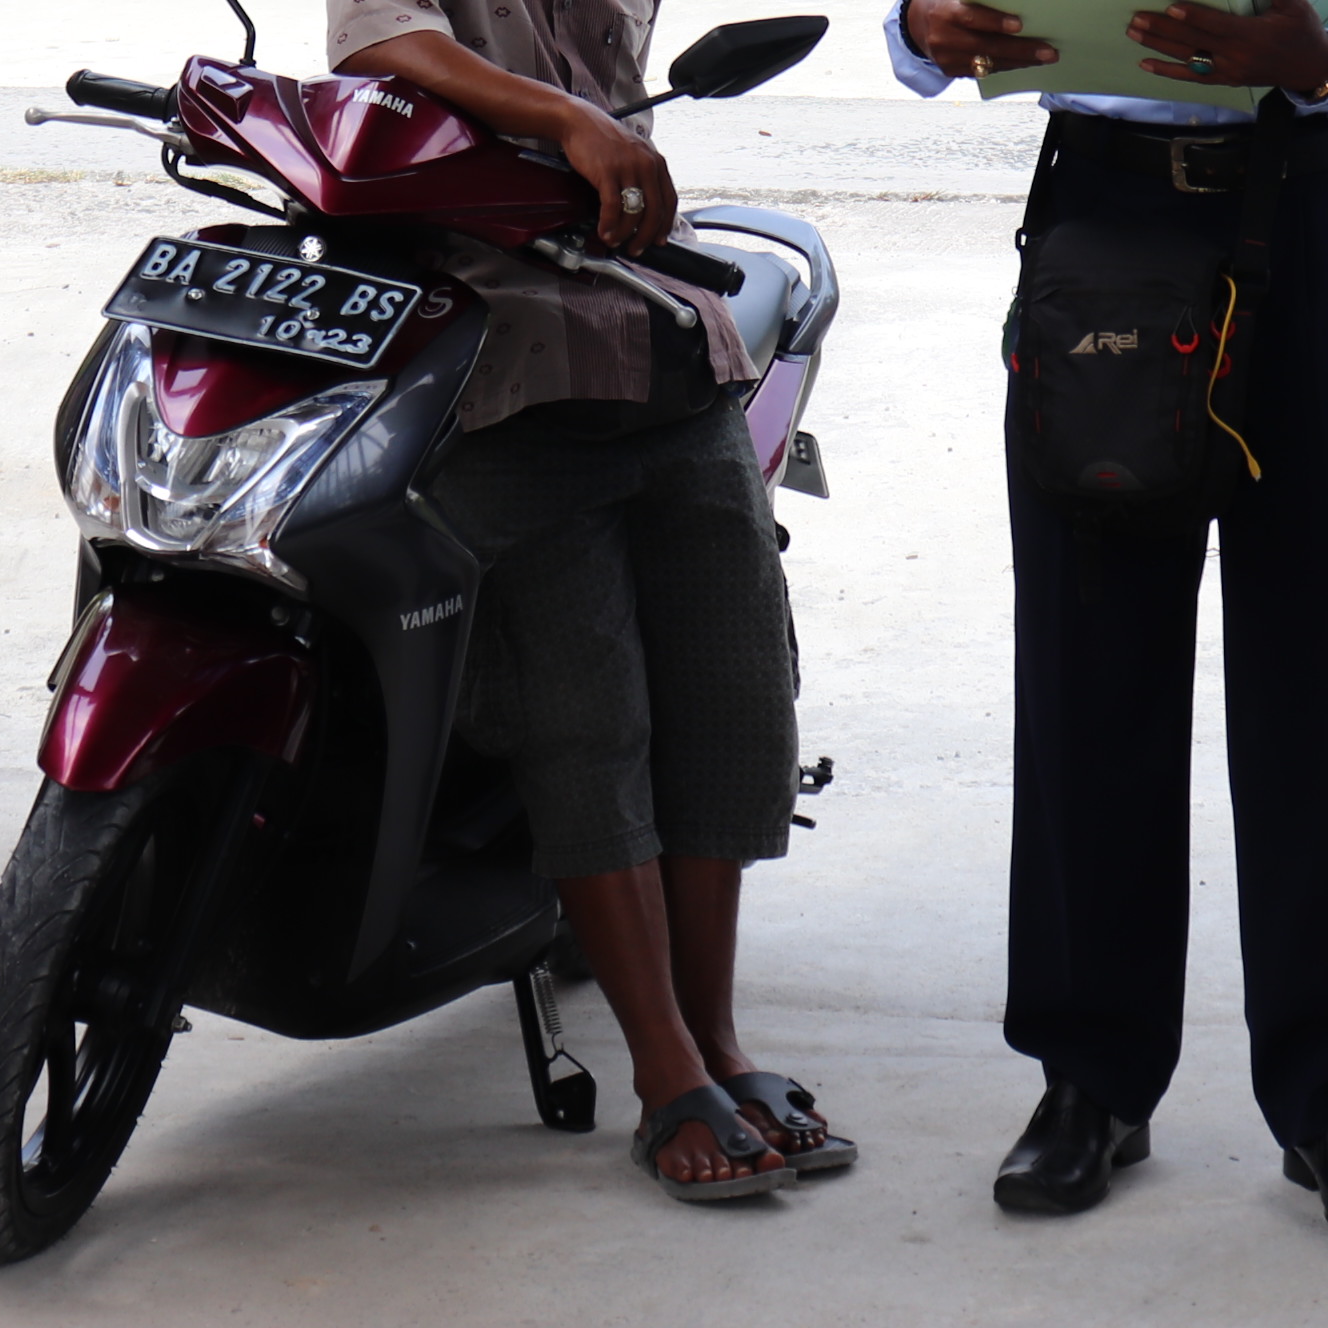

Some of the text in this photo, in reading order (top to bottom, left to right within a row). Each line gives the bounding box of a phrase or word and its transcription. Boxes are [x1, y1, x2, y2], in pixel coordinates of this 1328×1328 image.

[353, 89, 414, 119] YAMAHA
[139, 244, 405, 322] BA 2122 BS
[259, 315, 302, 341] 10
[399, 594, 463, 630] YAMAHA
